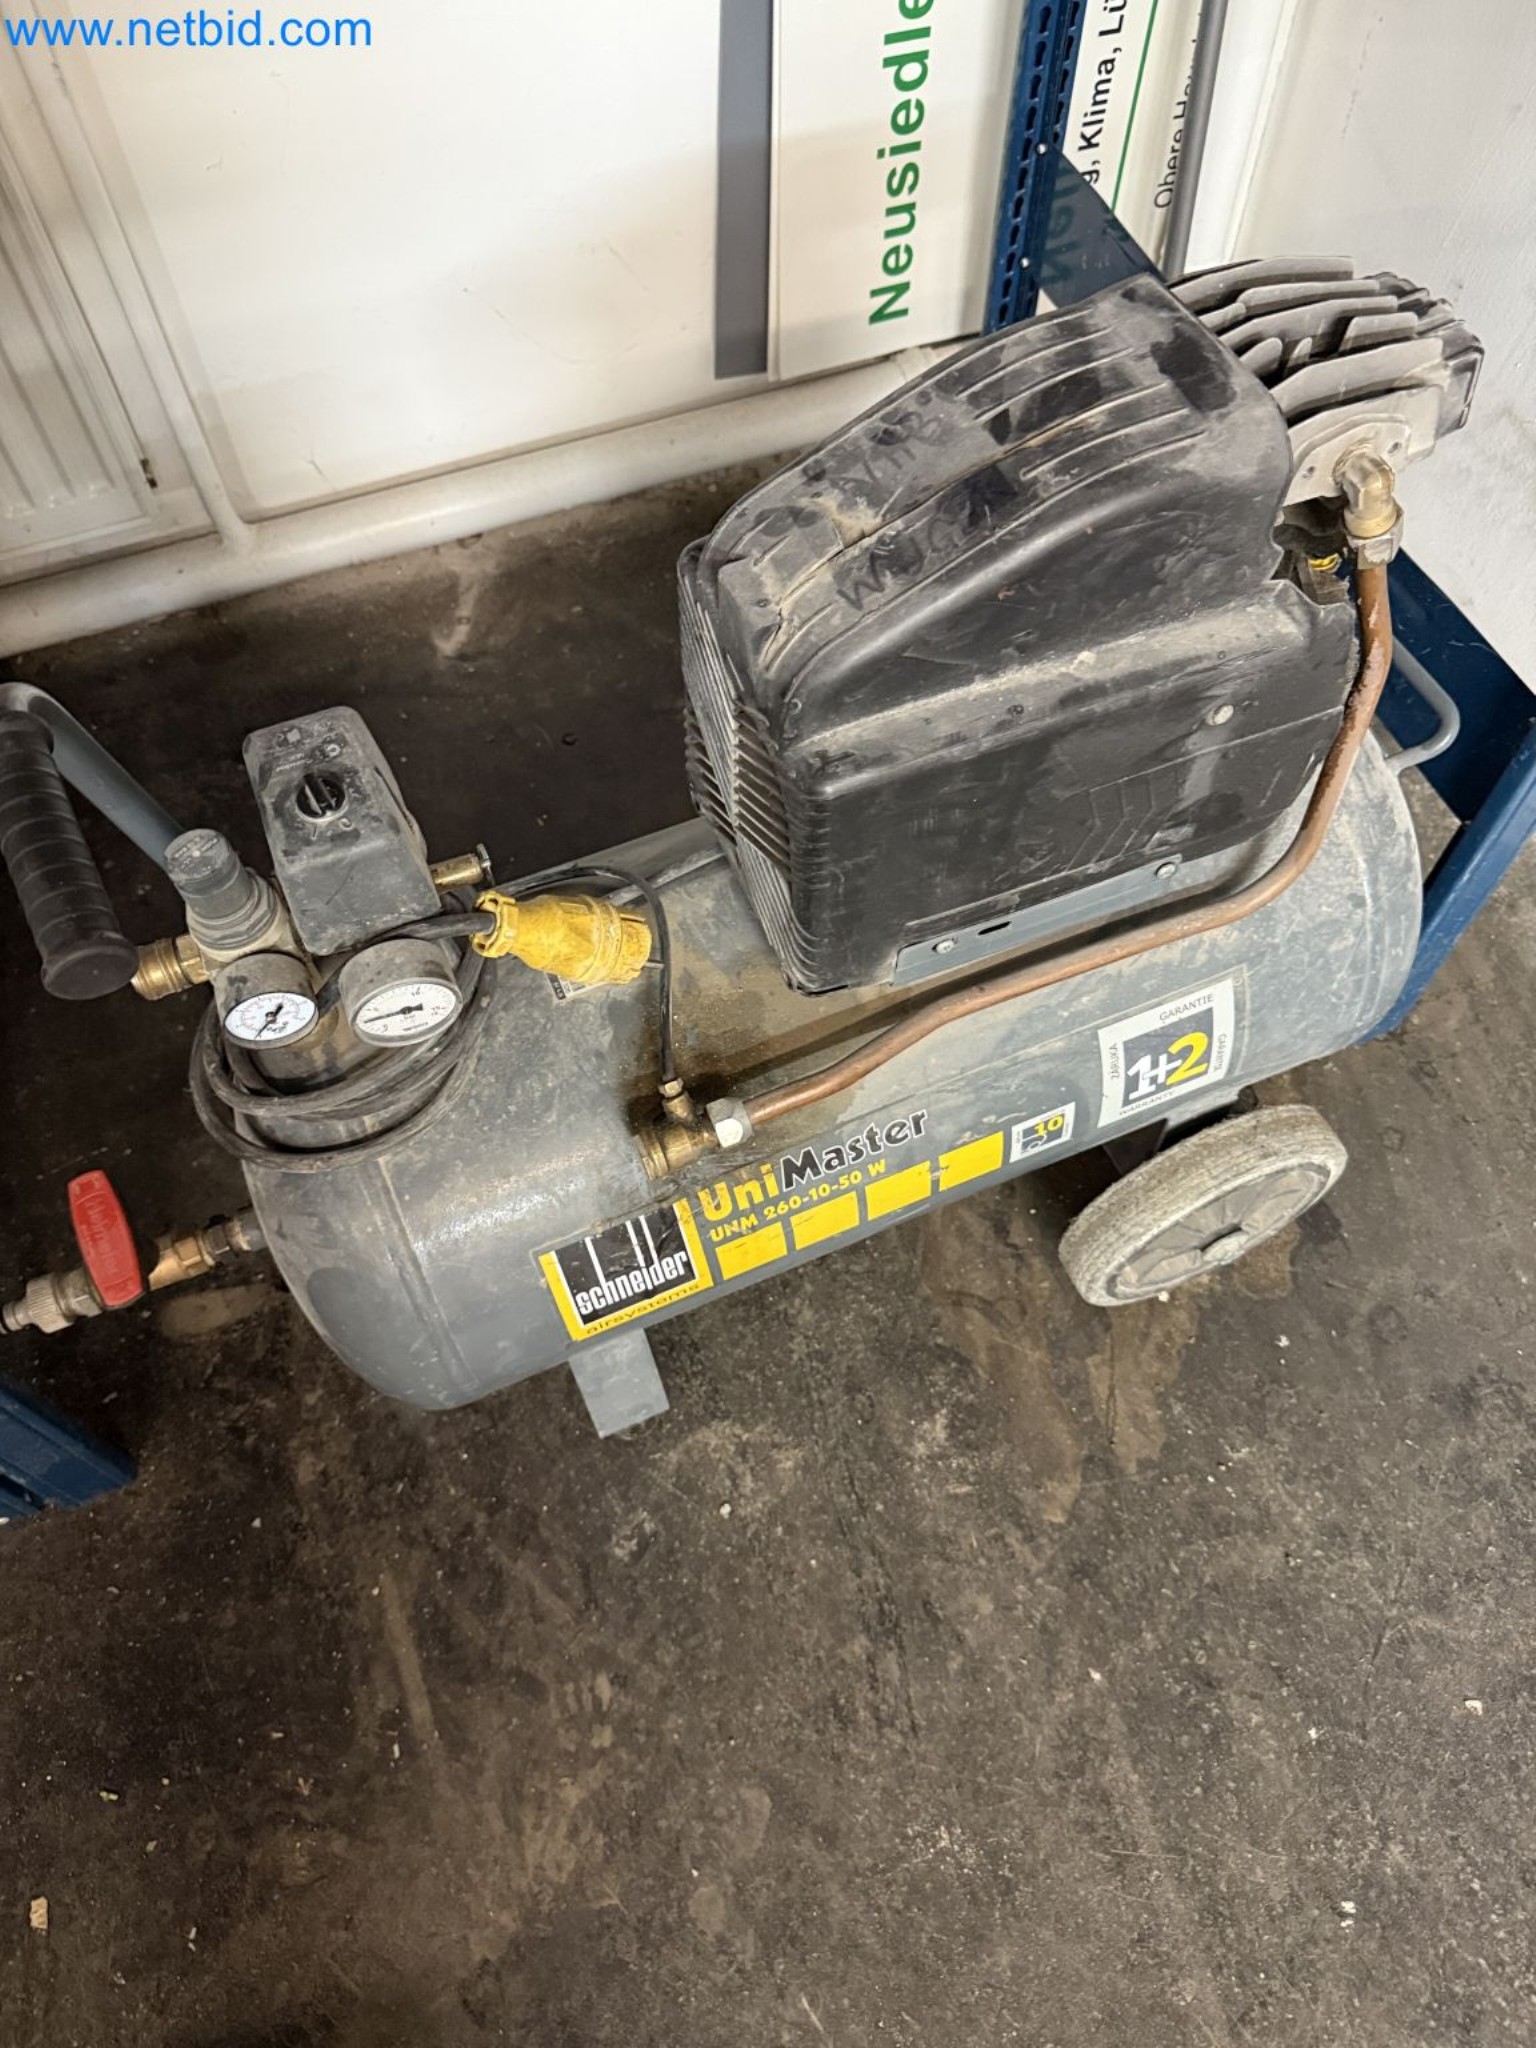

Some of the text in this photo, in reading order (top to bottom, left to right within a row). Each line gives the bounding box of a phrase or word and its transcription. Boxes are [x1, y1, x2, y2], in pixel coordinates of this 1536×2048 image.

[1077, 47, 1122, 151] Klima,
[1159, 992, 1214, 1021] GARANTIE
[1127, 1031, 1209, 1100] 1+2
[1034, 1115, 1063, 1135] 10
[697, 1109, 929, 1221] UniMaster
[709, 1158, 887, 1242] UNM 260-10-50 W
[575, 1215, 689, 1316] schneider
[587, 1282, 700, 1335] airsystems
